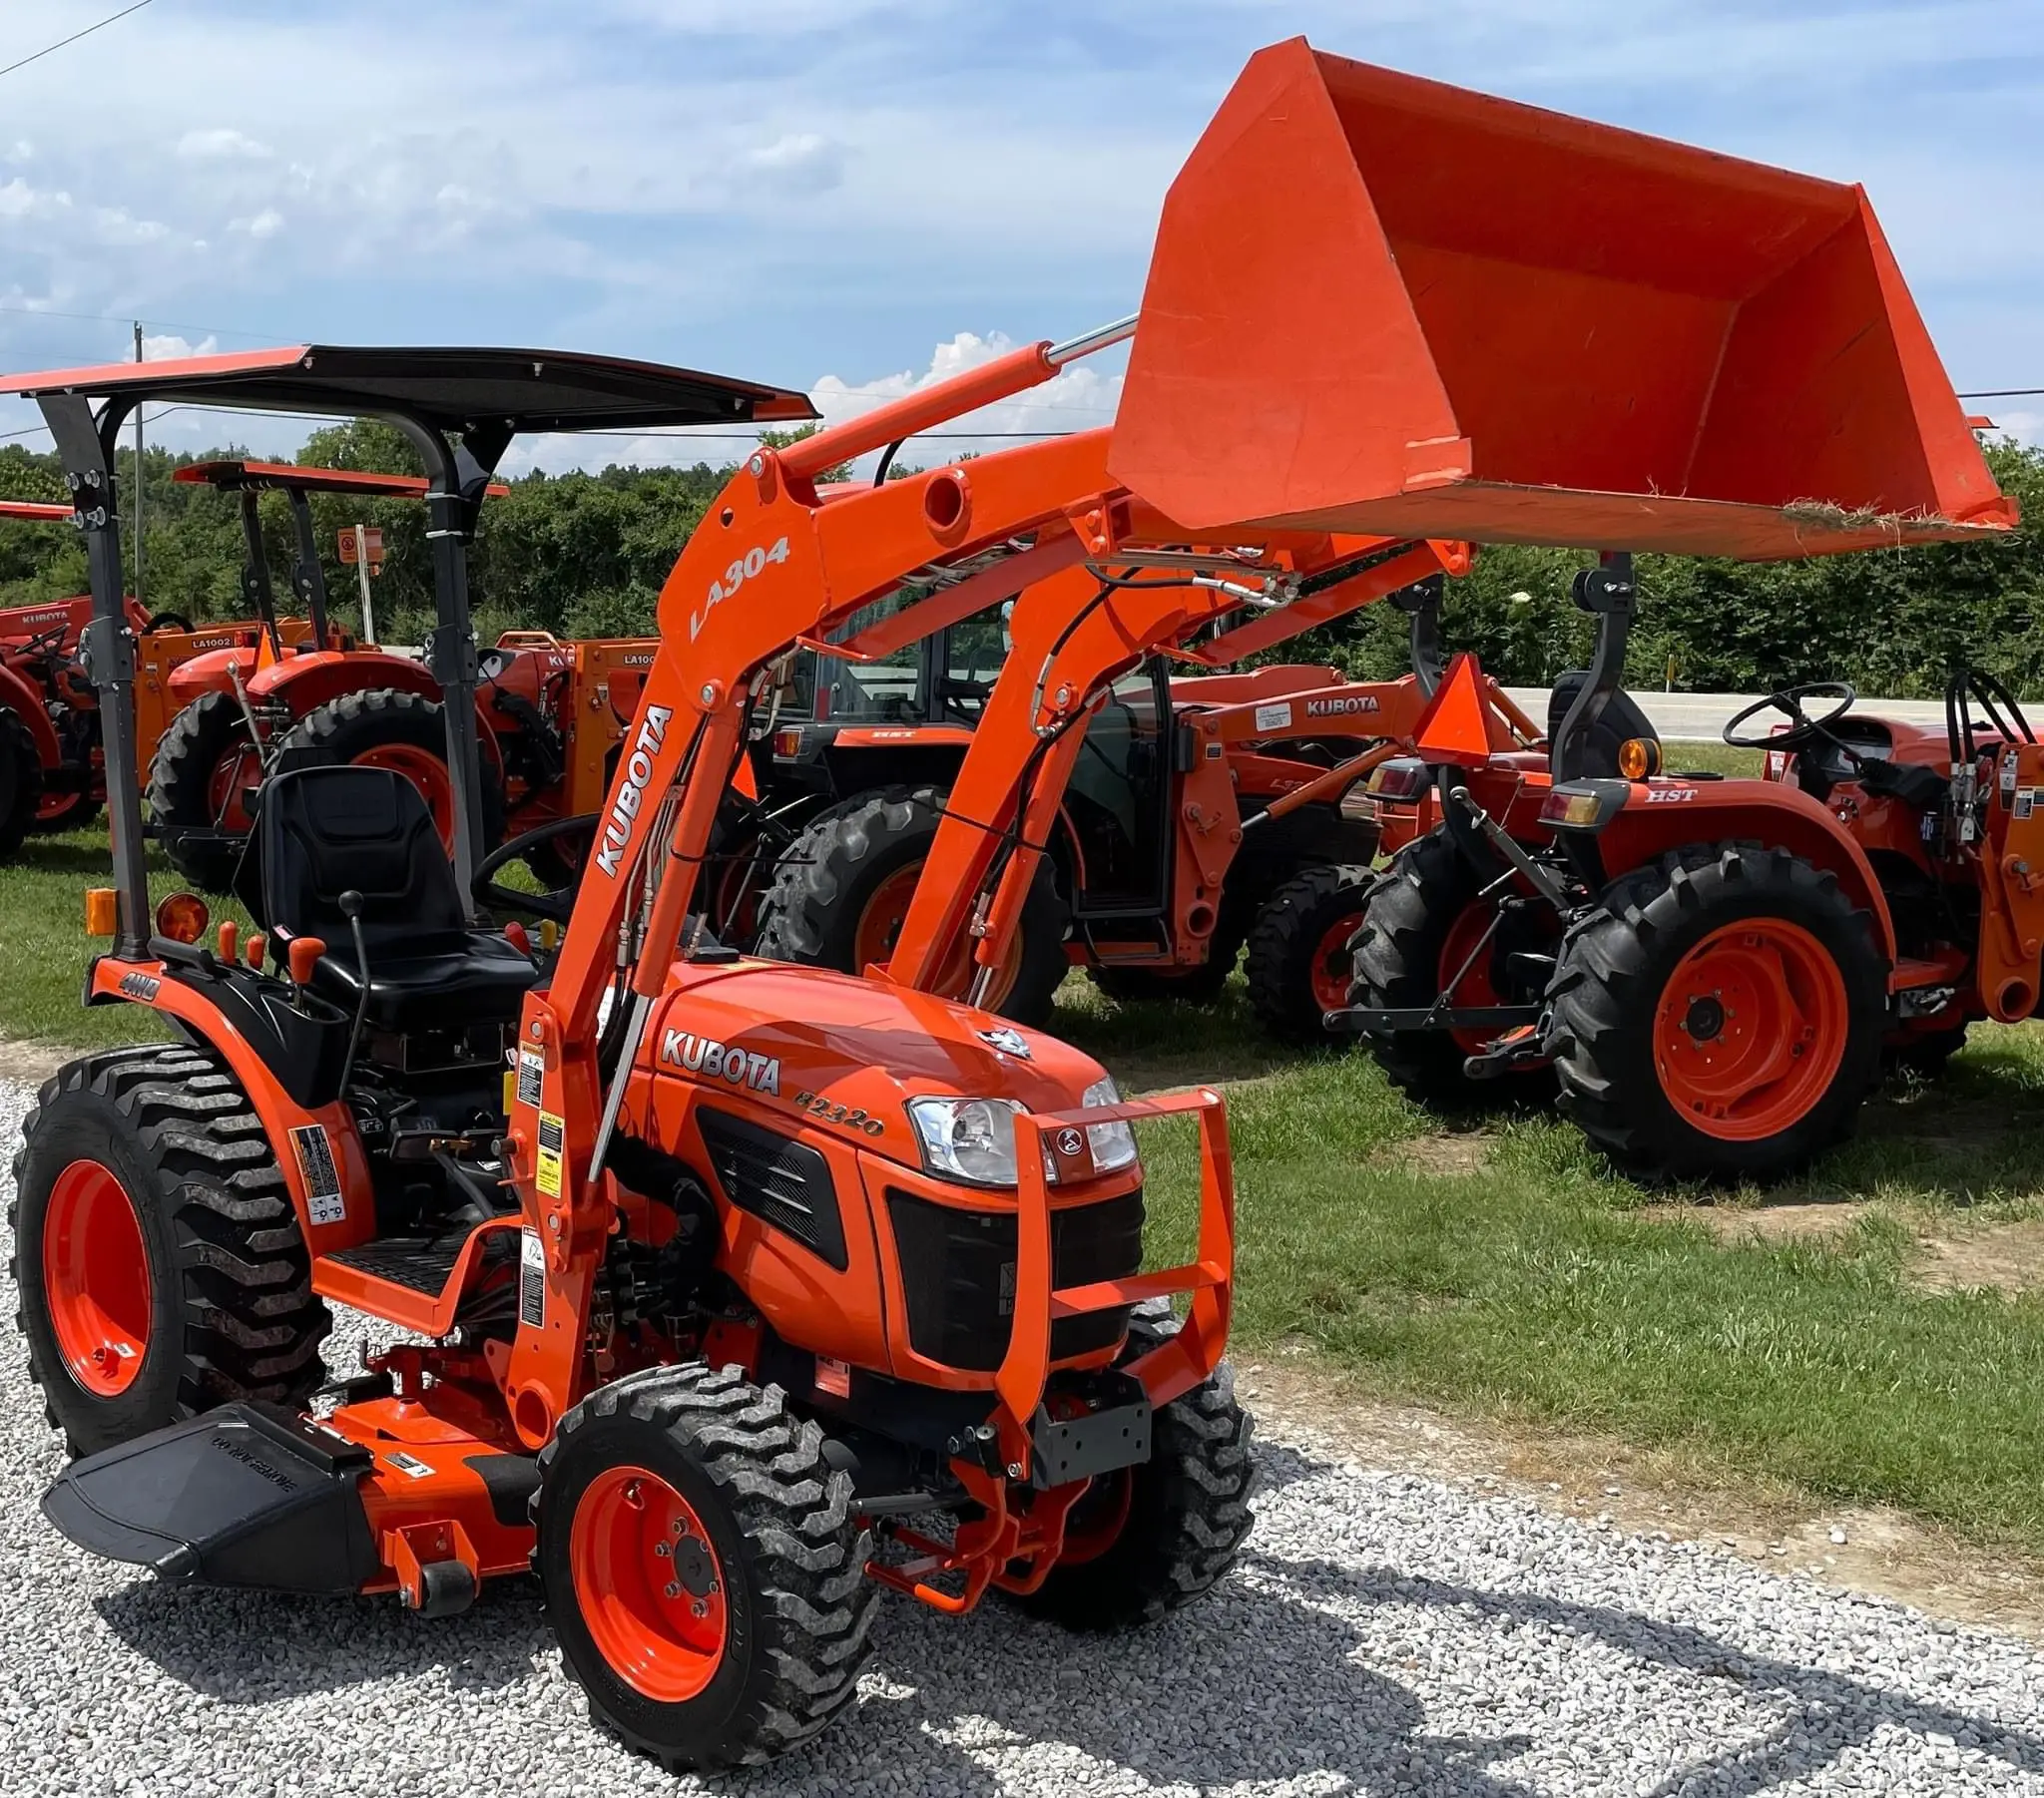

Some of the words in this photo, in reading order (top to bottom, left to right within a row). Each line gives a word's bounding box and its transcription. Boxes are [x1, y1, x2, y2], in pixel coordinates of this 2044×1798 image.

[690, 536, 789, 644] LA304
[22, 612, 68, 625] KUBOTA
[192, 638, 232, 649] LA1002
[624, 655, 657, 665] LA100
[1306, 695, 1380, 717] KUBOTA
[595, 702, 675, 879] KUBOTA
[1645, 789, 1698, 802] HST
[119, 971, 161, 1002] 4WD
[661, 1028, 781, 1097] KUBOTA
